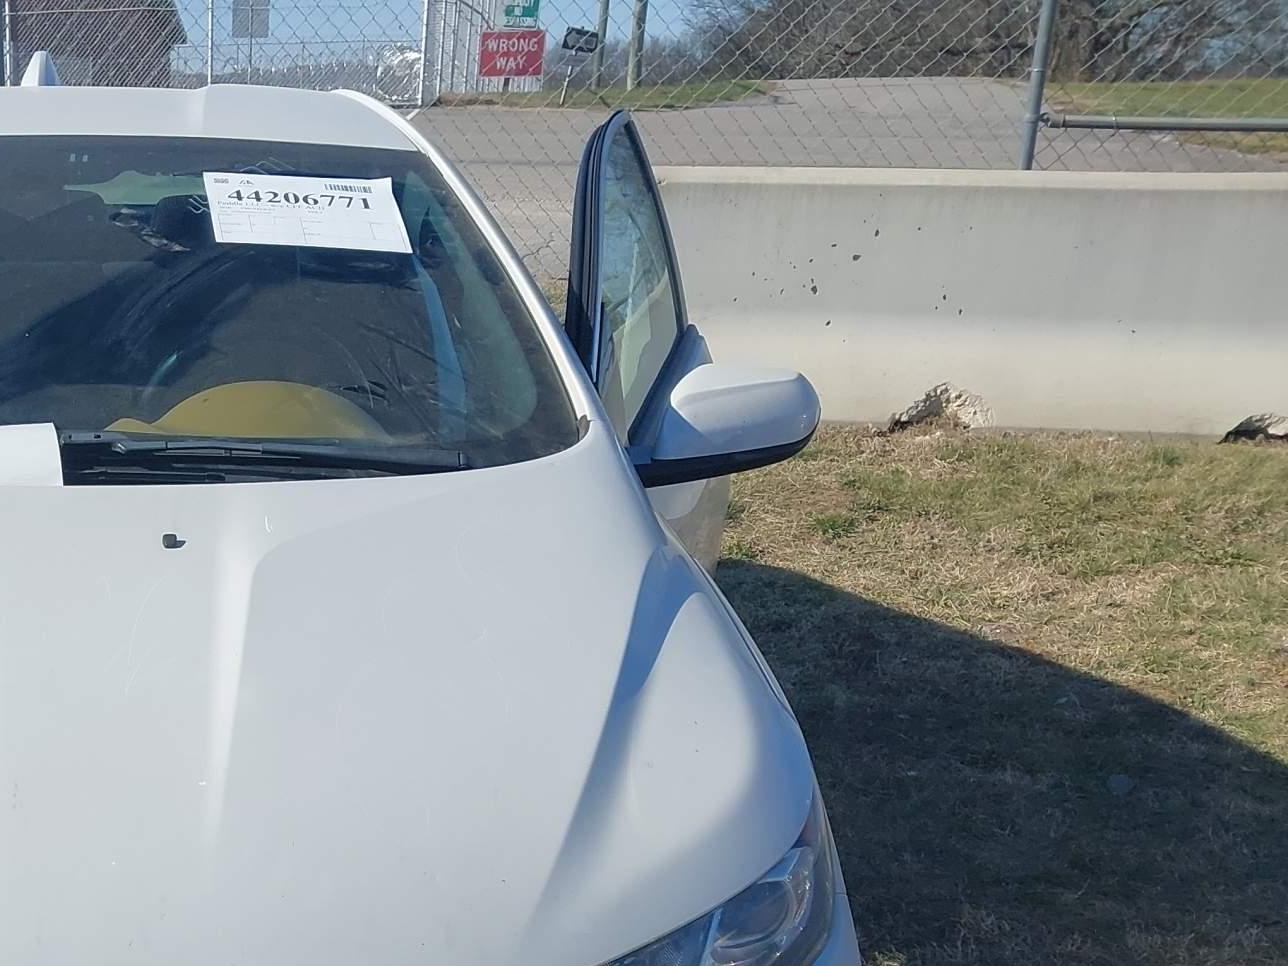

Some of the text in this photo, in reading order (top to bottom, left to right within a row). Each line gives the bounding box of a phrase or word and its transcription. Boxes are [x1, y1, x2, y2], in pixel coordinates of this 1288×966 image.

[487, 38, 538, 52] WRONG
[495, 56, 527, 70] WAY
[227, 189, 376, 210] 44206771
